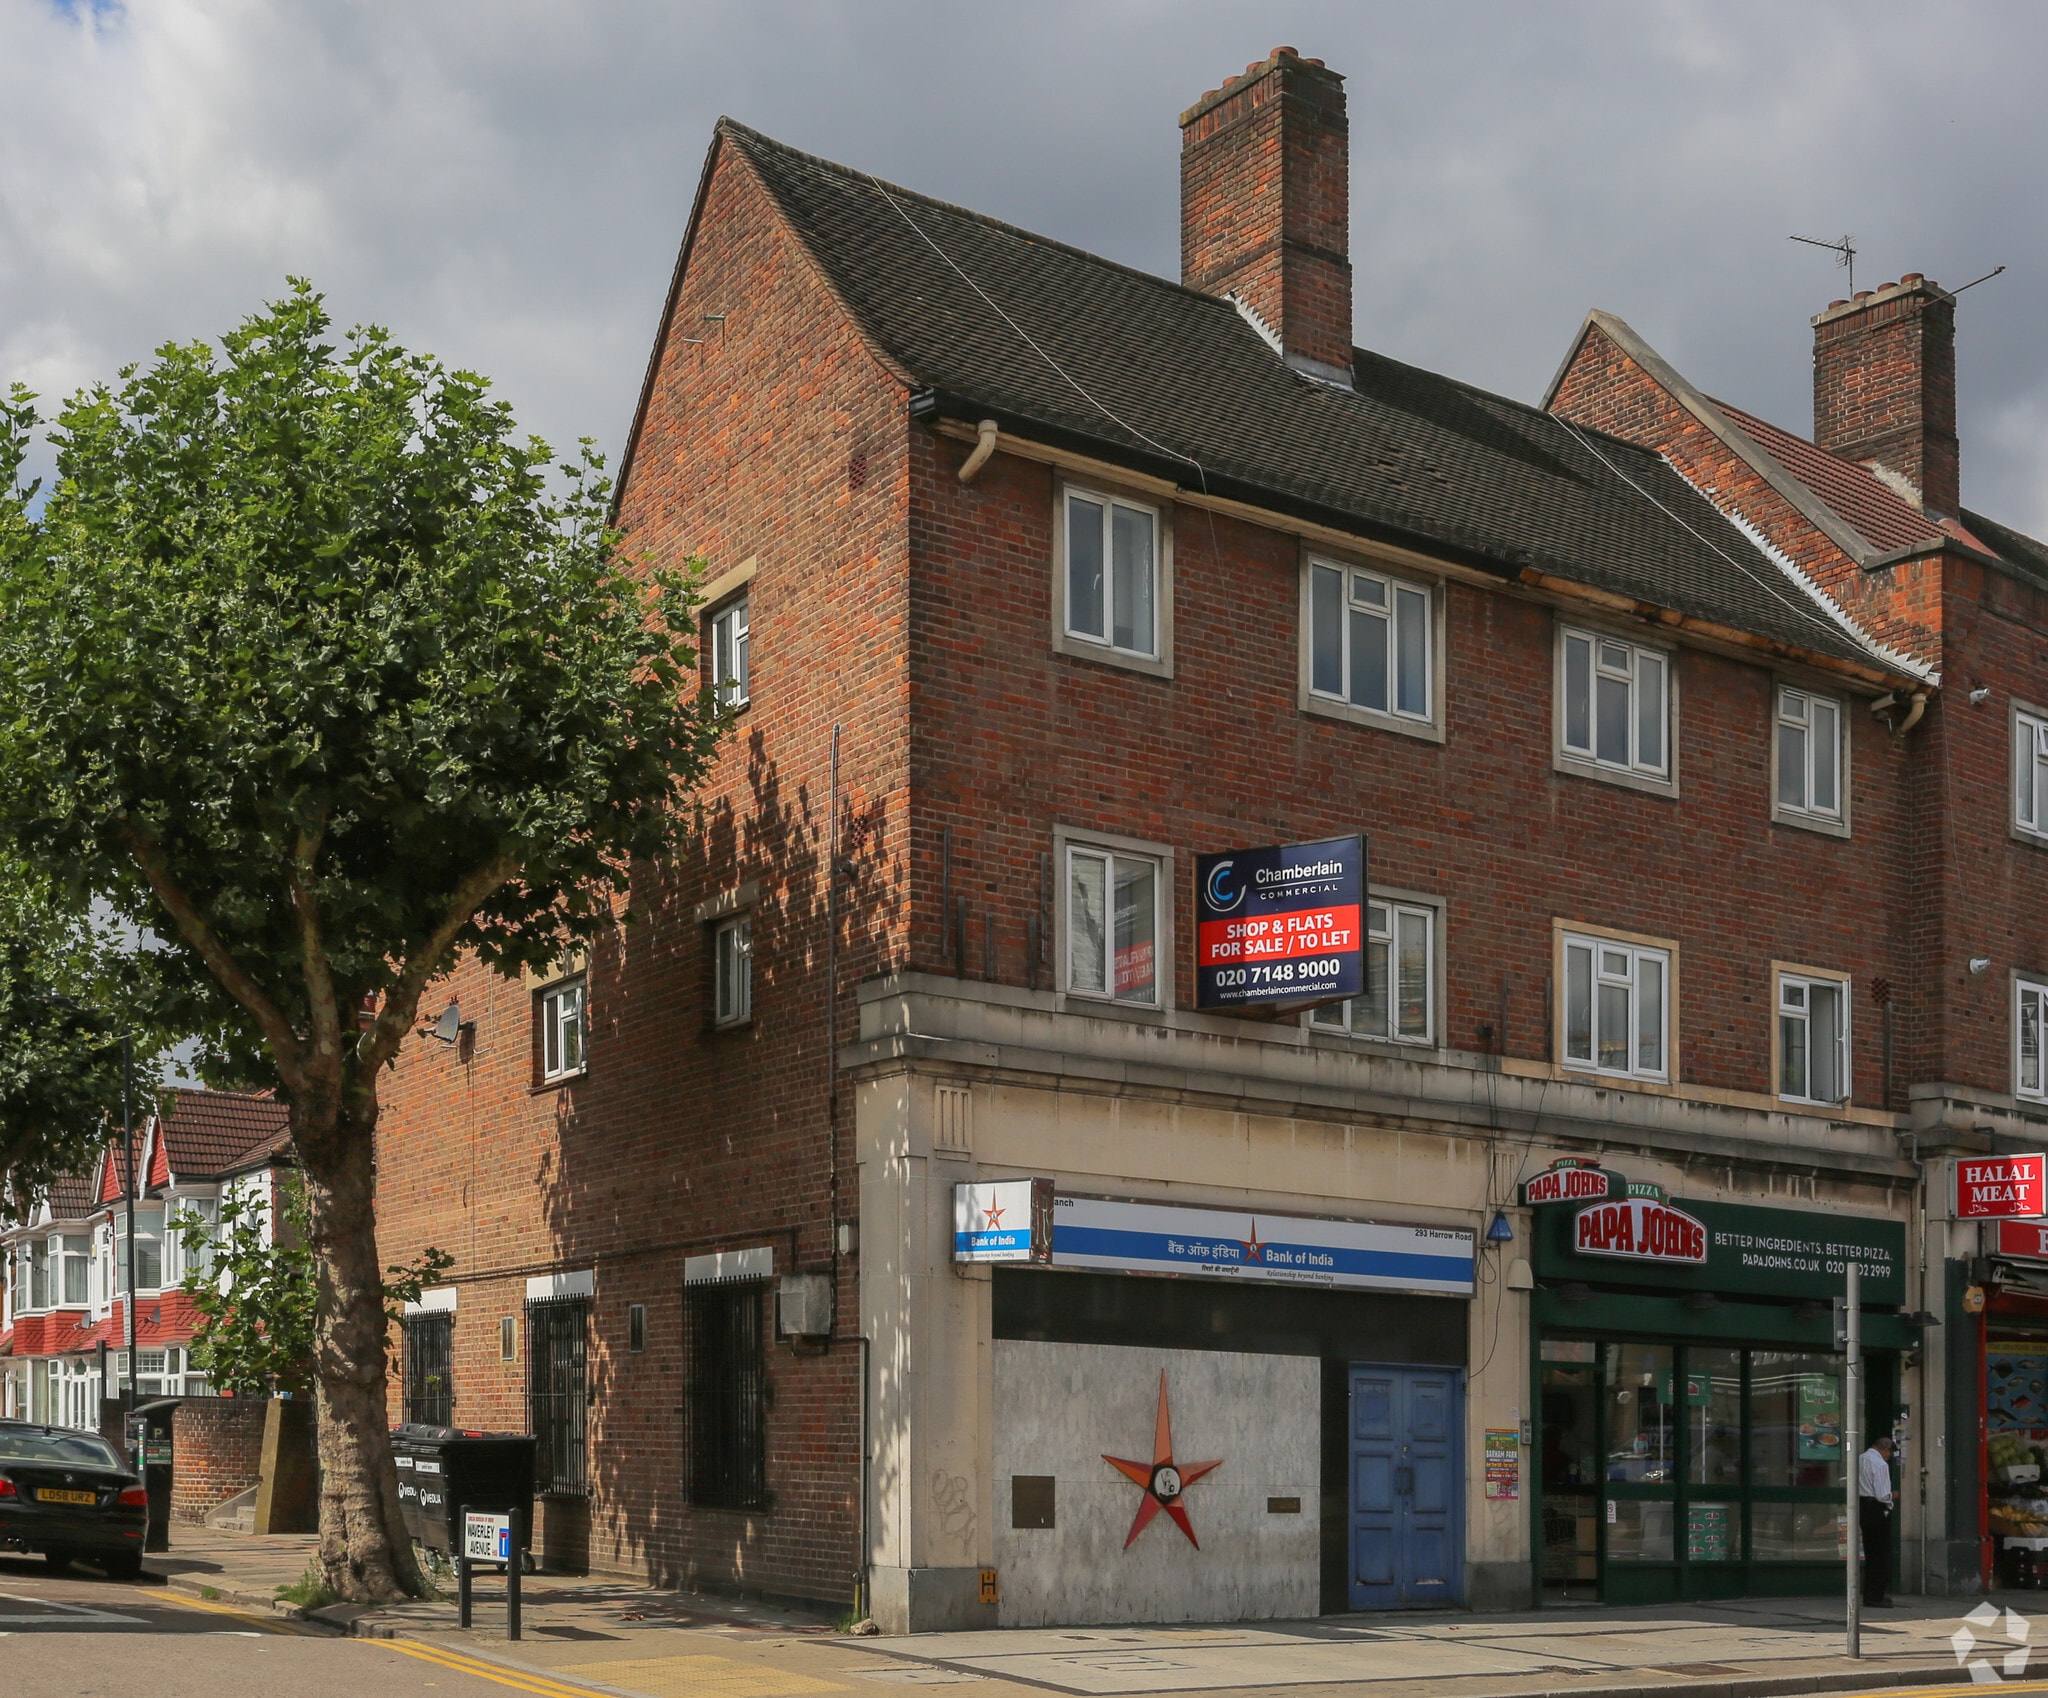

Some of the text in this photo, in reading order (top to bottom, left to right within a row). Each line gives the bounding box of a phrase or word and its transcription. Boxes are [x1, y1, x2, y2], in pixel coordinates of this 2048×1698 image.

[1255, 860, 1343, 884] Chamberlain
[1260, 884, 1338, 900] COMMERCIAL
[1227, 913, 1334, 939] SHOP & FLATS
[1211, 930, 1350, 958] FOR SALE / TO LET
[1216, 958, 1340, 987] 020 7148 9000
[1220, 981, 1337, 1000] www.chamberlaincommercial.com
[1556, 1159, 1577, 1168] PIZZA
[1965, 1164, 2036, 1183] HALAL
[1528, 1173, 1562, 1201] PAPA
[1627, 1183, 1659, 1198] PIZZA
[1971, 1184, 2030, 1203] MEAT
[1968, 1202, 2031, 1214] حلال حلال
[971, 1235, 1016, 1247] Bank of India
[1415, 1229, 1472, 1241] 293 Harrow Road
[1579, 1205, 1704, 1259] PAPA JOHN'S
[1168, 1239, 1185, 1255] बैंक
[1211, 1243, 1240, 1260] इंडिया
[1715, 1232, 1753, 1248] BETTER
[1755, 1236, 1824, 1255] INGREDIENTS.
[1826, 1243, 1862, 1258] BETTER
[1266, 1249, 1334, 1267] Bank of India
[1742, 1253, 1820, 1272] PAPAJOHNS.CO.UK
[1826, 1261, 1845, 1274] 020
[1870, 1264, 1891, 1278] 2999
[1266, 1269, 1334, 1282] Relationship beyond banking
[71, 1492, 91, 1503] URZ
[467, 1523, 495, 1539] WAVERLEY
[470, 1541, 491, 1556] AVENUE
[982, 1574, 996, 1595] H
